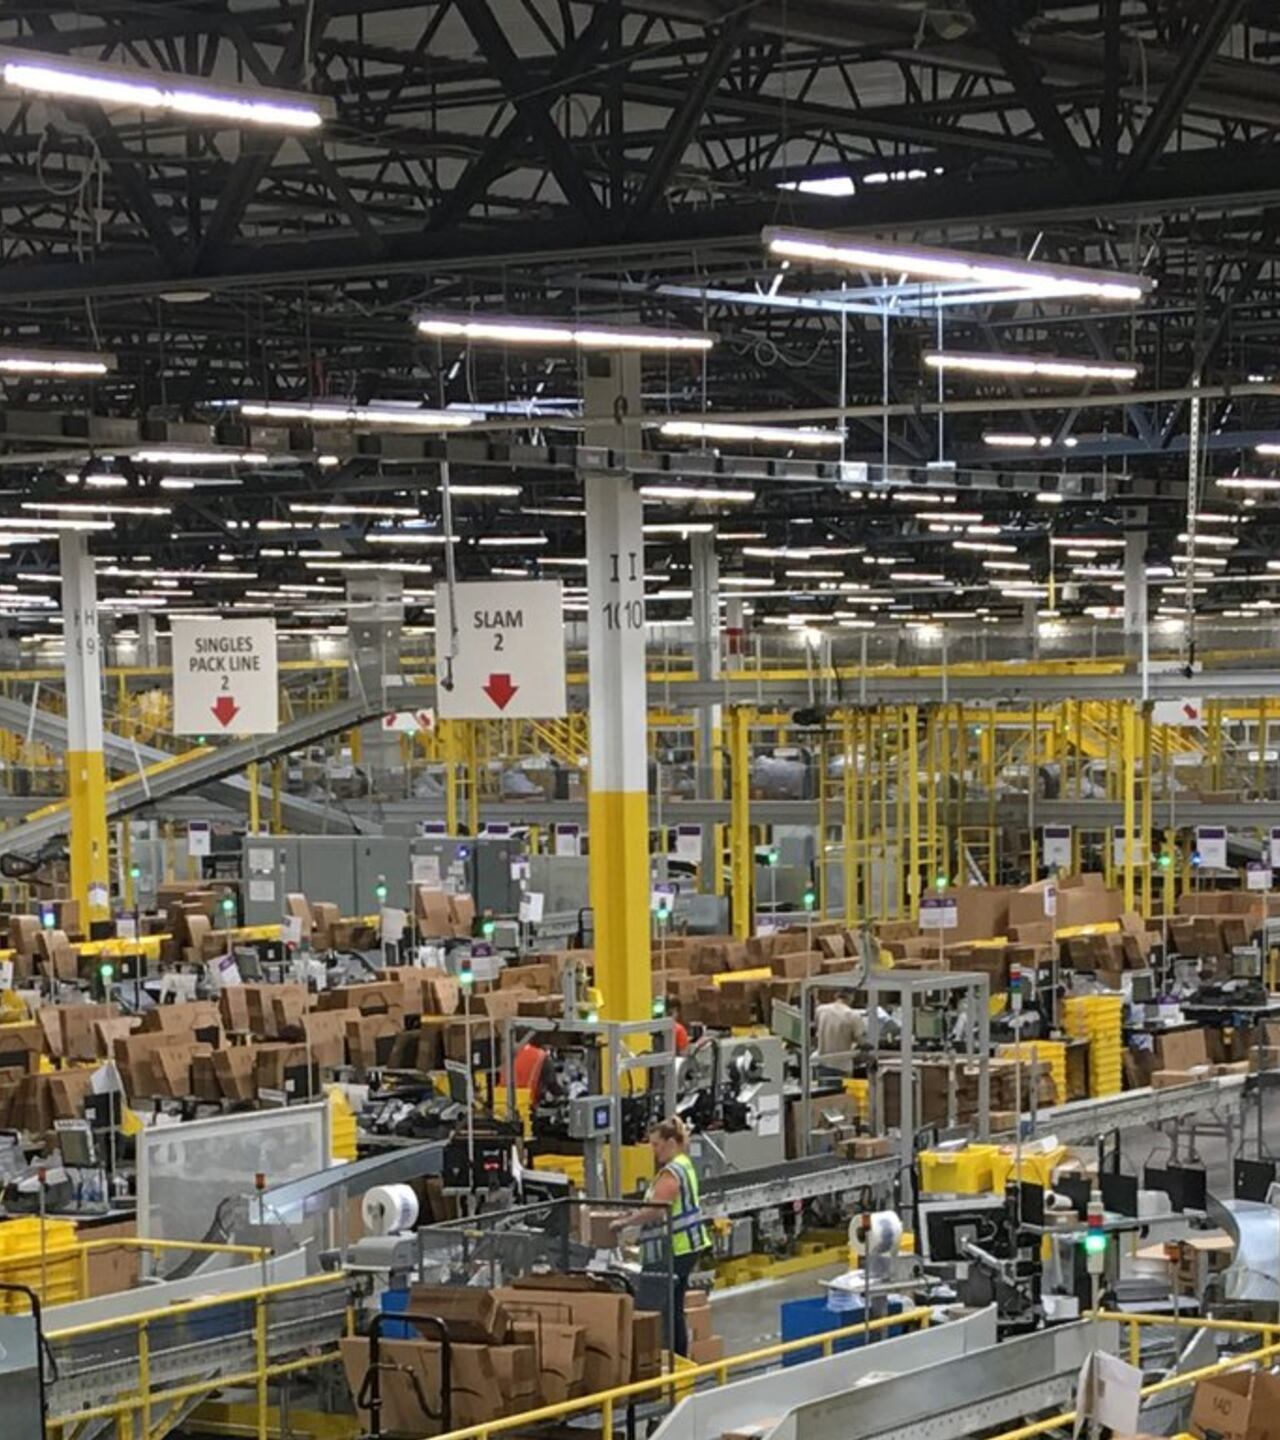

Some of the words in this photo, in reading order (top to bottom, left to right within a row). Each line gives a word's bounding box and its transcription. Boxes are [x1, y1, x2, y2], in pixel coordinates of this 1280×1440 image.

[474, 610, 524, 628] SLAM
[624, 600, 643, 629] 10
[195, 637, 253, 653] SINGLES
[494, 634, 504, 651] 2
[189, 657, 222, 672] PACK
[230, 656, 260, 671] LINE
[221, 676, 229, 690] 2
